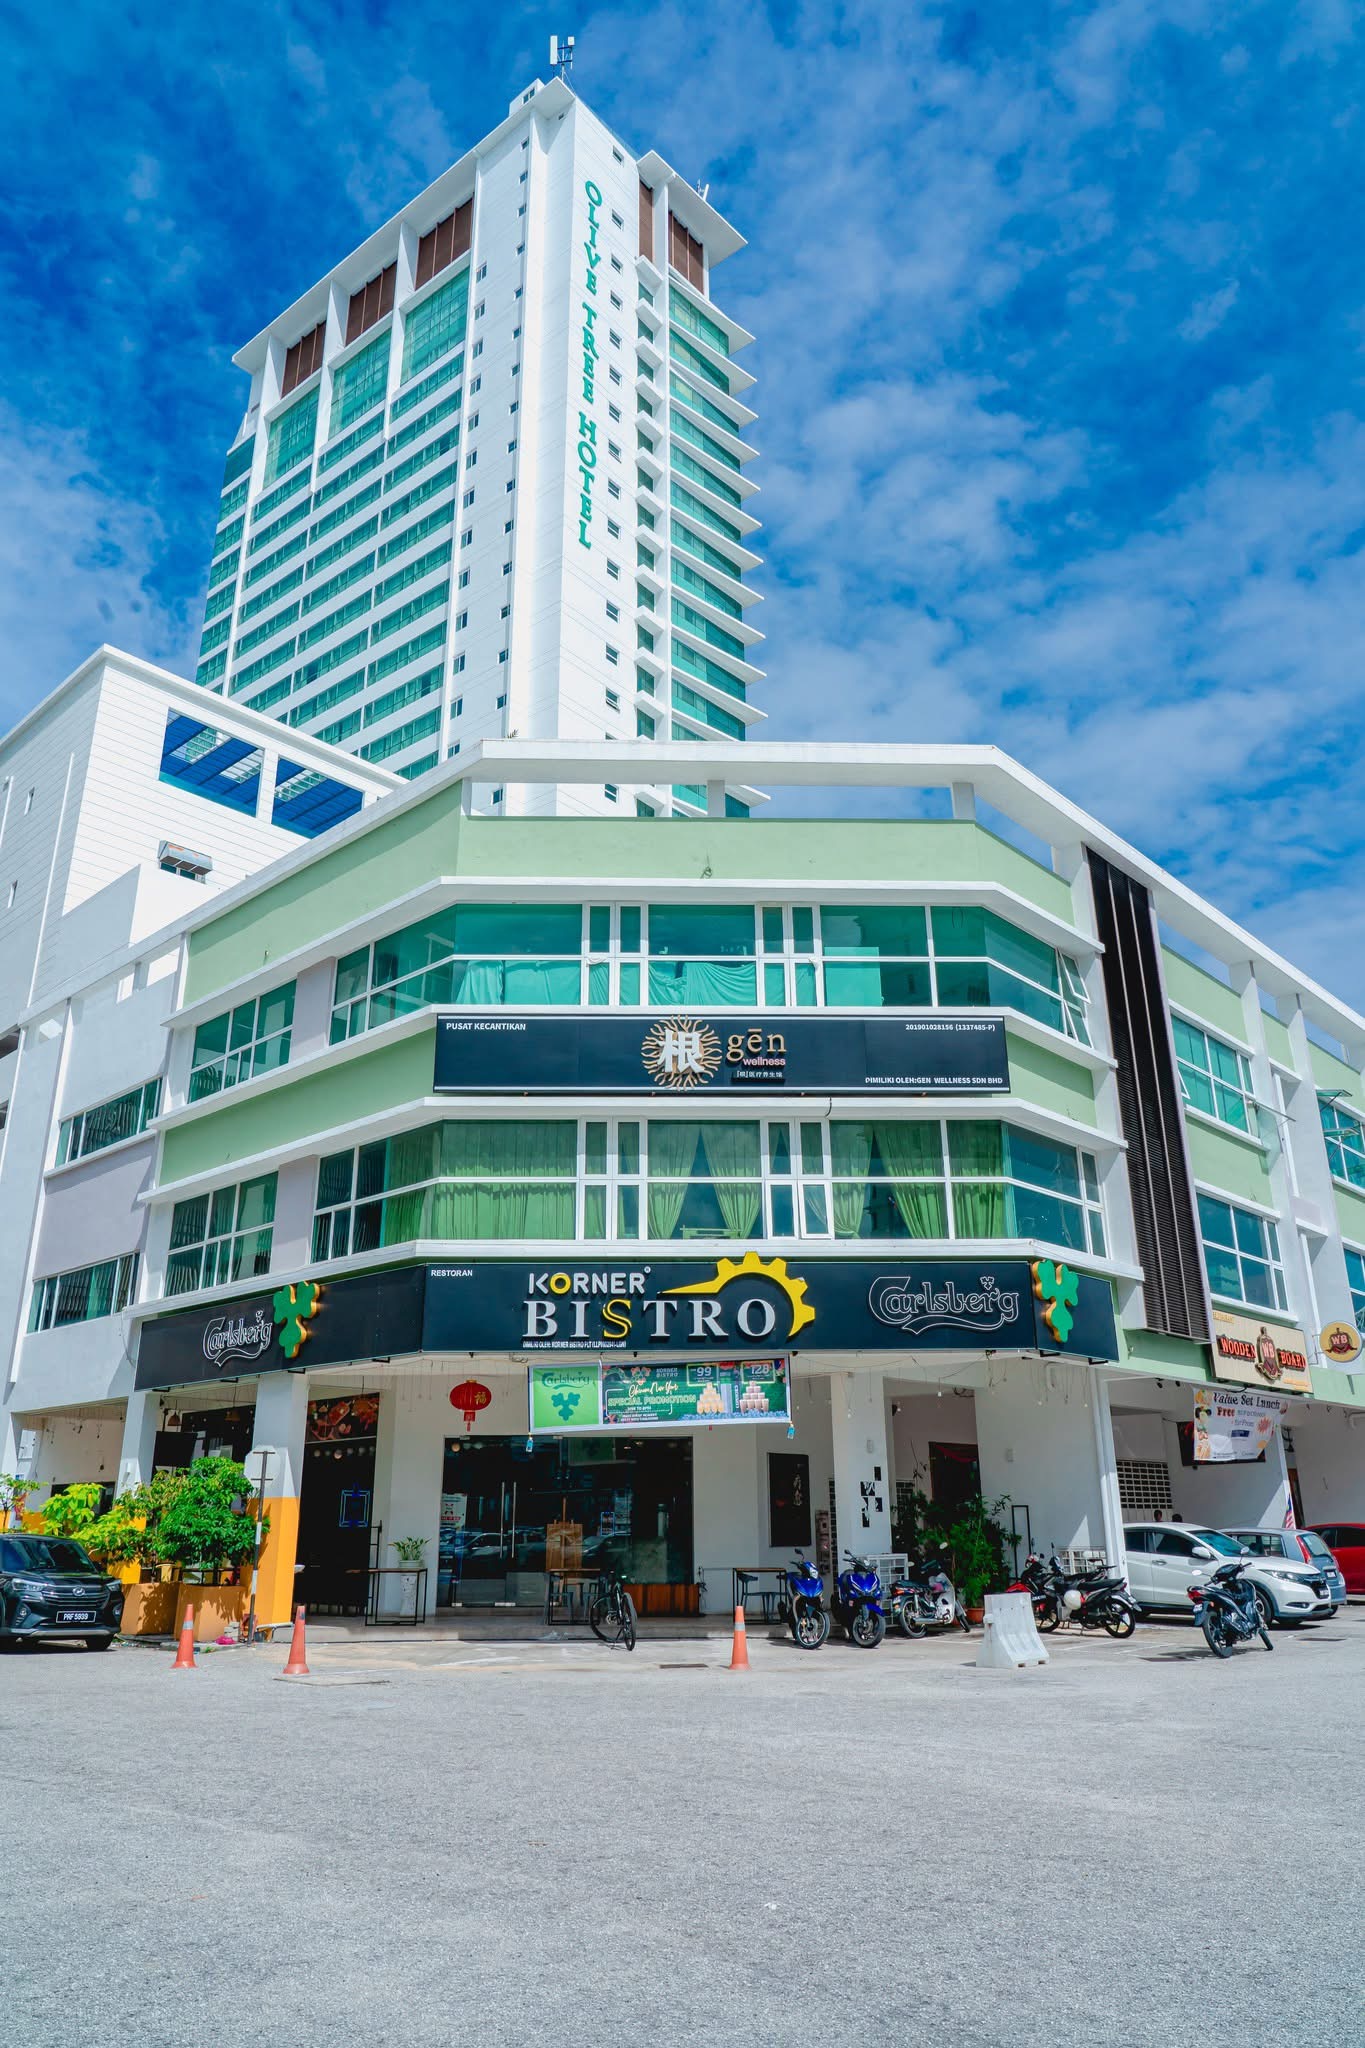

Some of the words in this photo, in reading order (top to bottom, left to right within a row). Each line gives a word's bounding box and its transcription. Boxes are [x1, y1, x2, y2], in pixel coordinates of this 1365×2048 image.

[585, 180, 603, 296] OLIVE
[582, 302, 599, 405] TREE
[577, 411, 597, 550] HOTEL
[446, 1022, 472, 1030] PUSAT
[474, 1022, 526, 1031] KECANTIKAN
[905, 1023, 954, 1031] 201901028156
[656, 1026, 705, 1073] 根
[743, 1056, 787, 1066] wellness
[431, 1269, 473, 1277] RESTORAN
[528, 1272, 645, 1295] KORNER
[869, 1277, 1019, 1332] Carlsberg
[522, 1298, 776, 1338] BISTRO
[203, 1317, 272, 1363] Carlsberg
[1220, 1336, 1256, 1358] WOODEN
[1331, 1334, 1348, 1345] WB
[1262, 1341, 1275, 1358] WB
[1280, 1351, 1306, 1369] BOARD
[697, 1366, 711, 1377] 99
[750, 1363, 770, 1375] 128
[542, 1372, 589, 1388] Carlsberg
[608, 1397, 642, 1407] SPECIAL
[643, 1394, 696, 1405] PROMOTION
[1213, 1392, 1239, 1405] Value
[1240, 1394, 1254, 1407] Set
[1256, 1397, 1280, 1410] Lunch
[1217, 1406, 1235, 1417] Free
